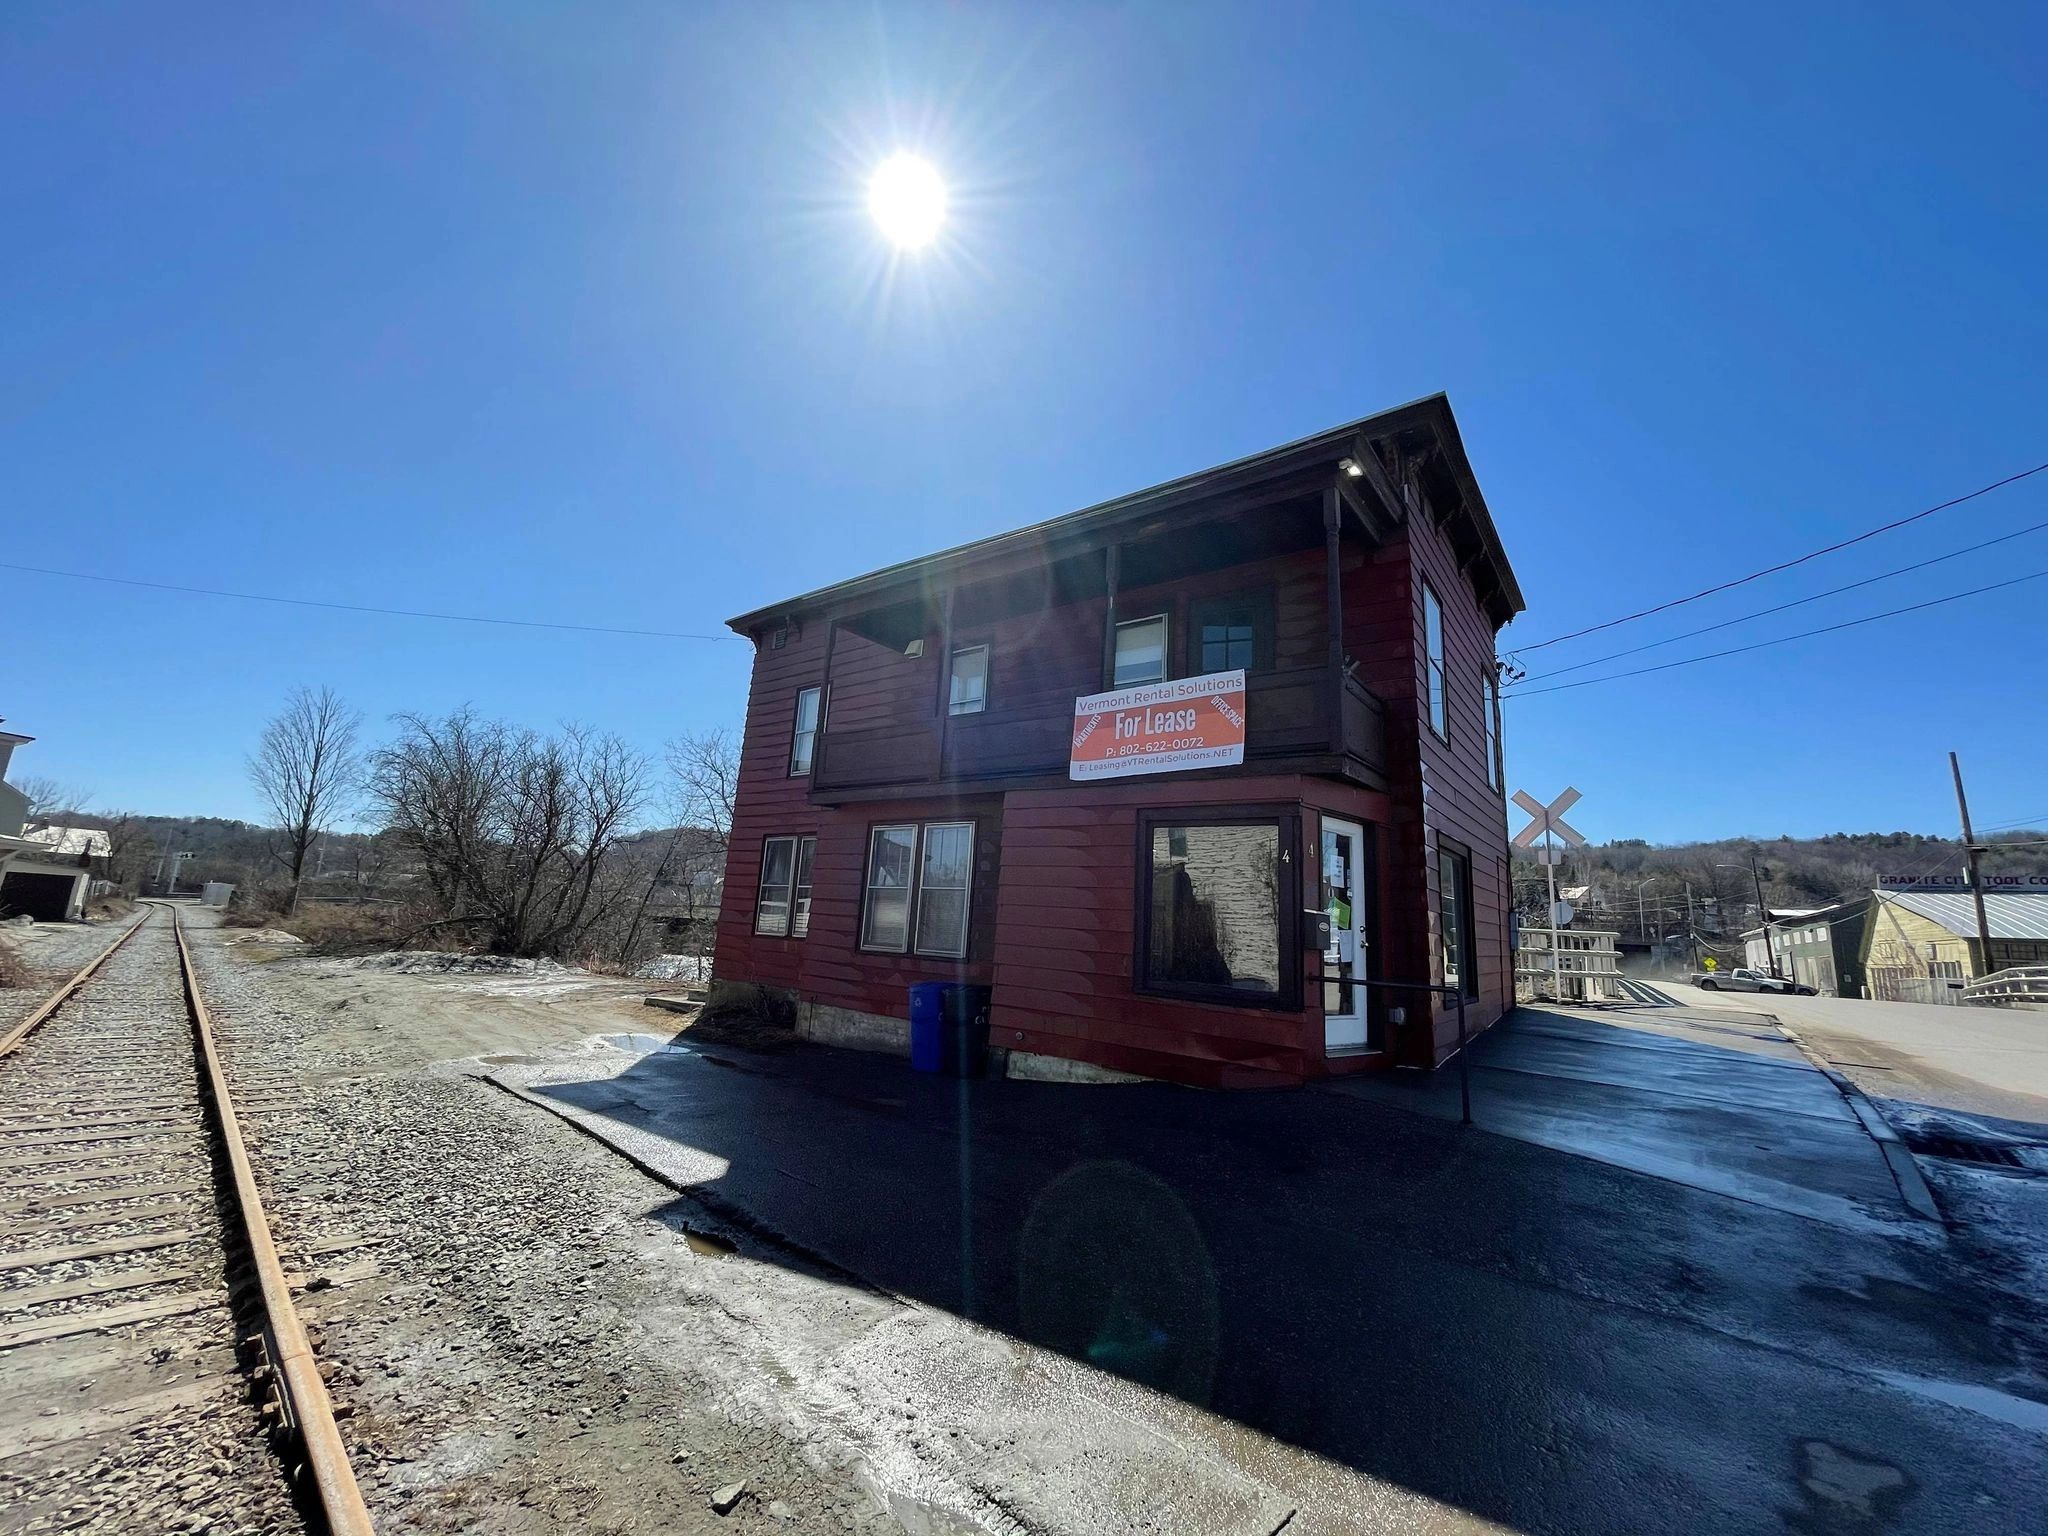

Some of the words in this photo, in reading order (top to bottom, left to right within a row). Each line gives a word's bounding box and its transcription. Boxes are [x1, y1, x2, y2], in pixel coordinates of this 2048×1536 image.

[1080, 695, 1130, 711] Vermont
[1134, 687, 1174, 704] Rental
[1178, 678, 1242, 696] Solutions
[1073, 713, 1102, 748] APARTMENTS
[1115, 712, 1141, 740] For
[1145, 708, 1196, 735] Lease
[1105, 747, 1117, 758] P:
[1119, 736, 1204, 756] 802-622-0072
[1282, 849, 1290, 863] 4
[1879, 875, 1939, 885] GRANITE
[1983, 876, 2024, 885] TOOL
